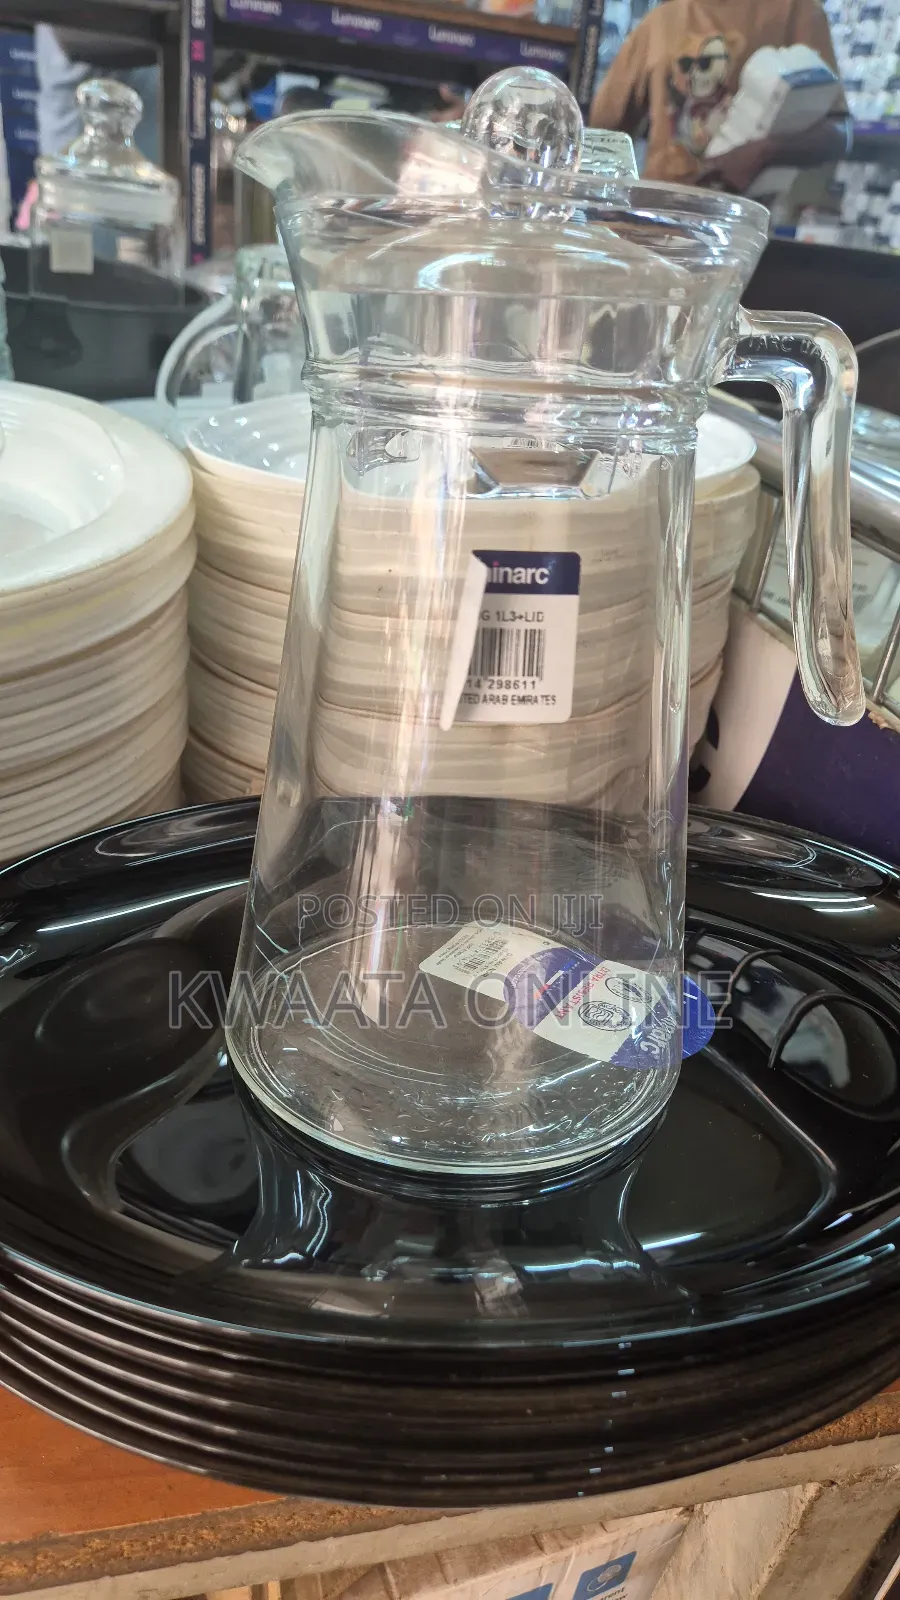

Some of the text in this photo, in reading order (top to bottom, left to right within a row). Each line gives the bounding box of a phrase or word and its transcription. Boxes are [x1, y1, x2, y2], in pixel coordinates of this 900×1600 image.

[479, 609, 490, 622] G
[488, 679, 536, 690] 298611
[482, 694, 508, 705] ARAB
[511, 694, 556, 706] EMIRATES
